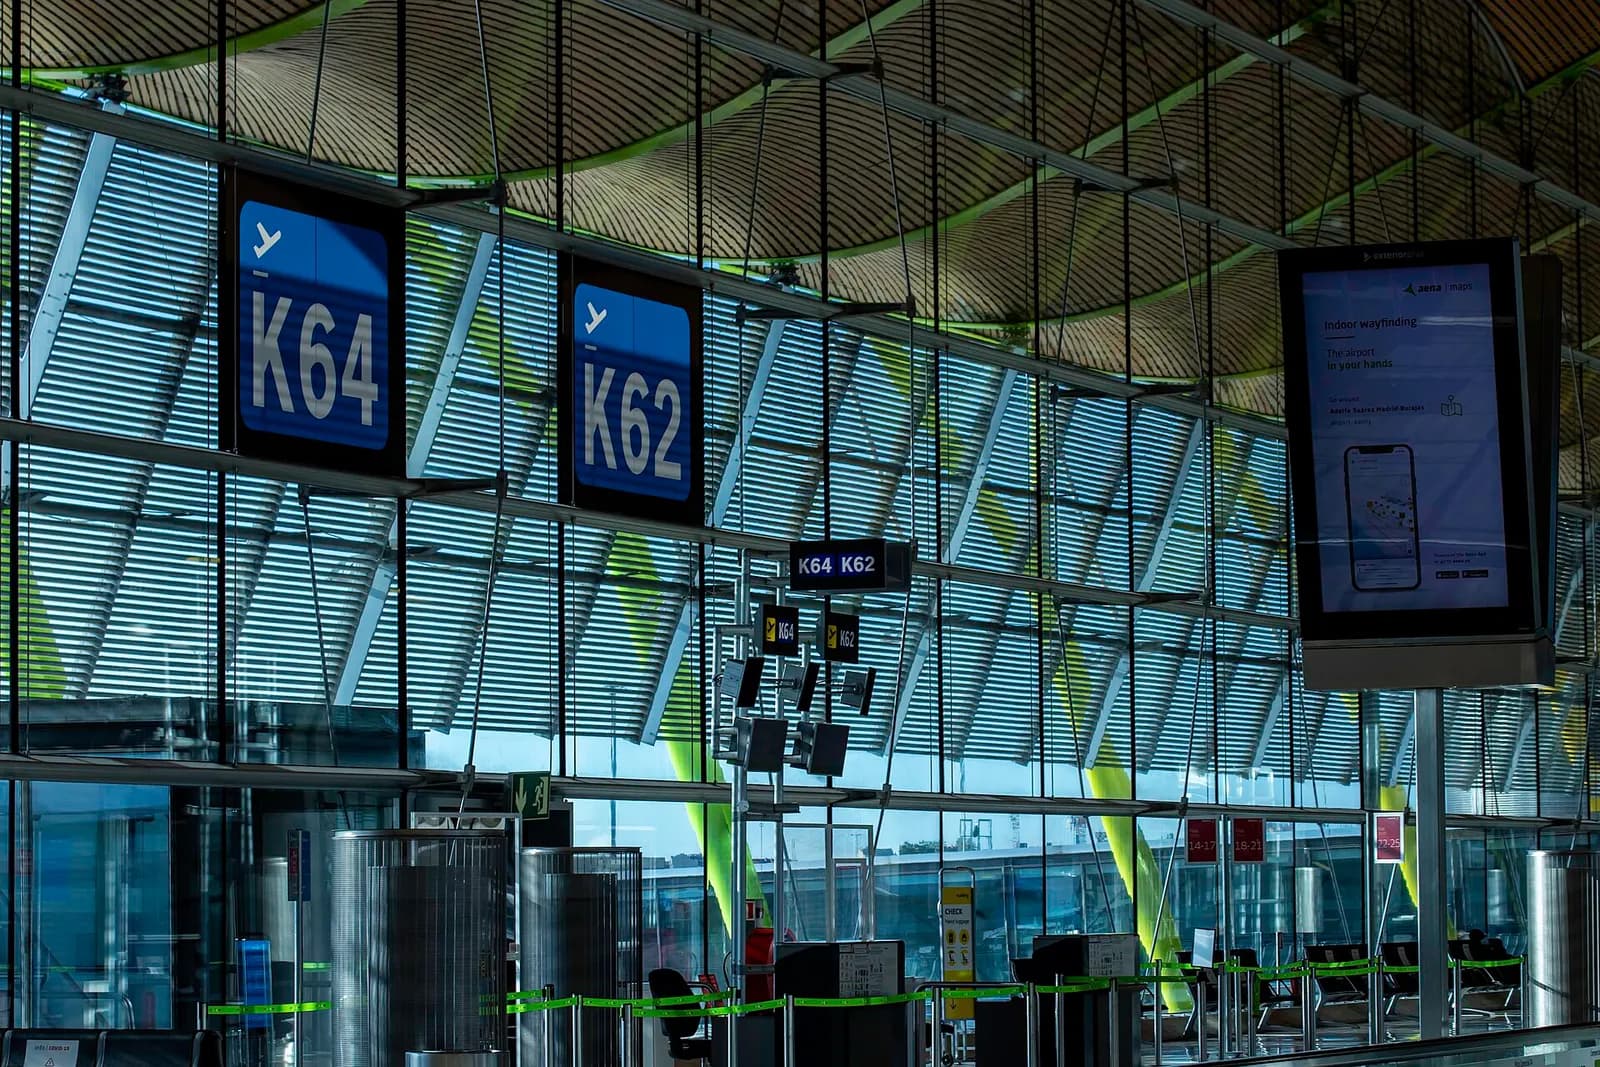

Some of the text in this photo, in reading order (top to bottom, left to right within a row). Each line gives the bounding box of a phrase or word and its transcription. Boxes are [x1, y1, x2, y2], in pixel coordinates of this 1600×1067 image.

[1418, 282, 1473, 293] aena maps
[1324, 317, 1417, 330] Indoor wayfinding
[253, 290, 379, 427] K64
[1327, 348, 1375, 359] The airport
[1327, 359, 1393, 372] in your hands
[584, 362, 682, 481] K62
[798, 556, 876, 574] K64 K62
[778, 622, 794, 641] K64
[839, 630, 855, 648] K62
[1188, 840, 1216, 851] 14-17
[1235, 840, 1262, 851] 18-21
